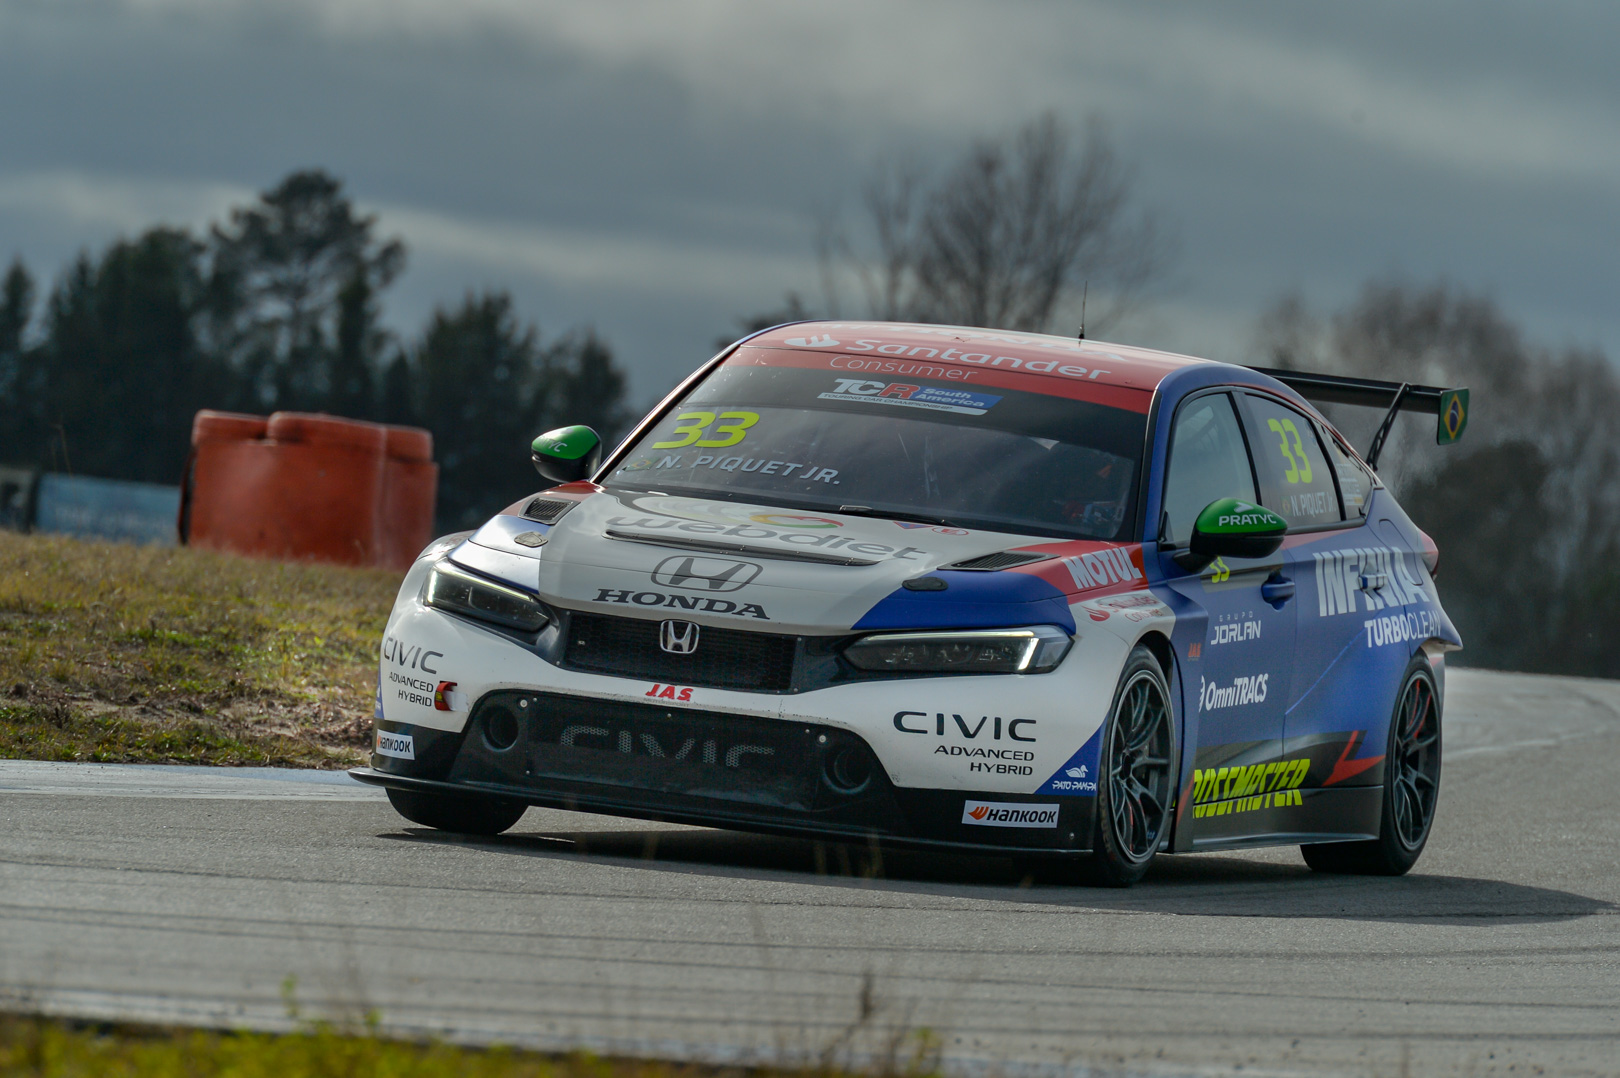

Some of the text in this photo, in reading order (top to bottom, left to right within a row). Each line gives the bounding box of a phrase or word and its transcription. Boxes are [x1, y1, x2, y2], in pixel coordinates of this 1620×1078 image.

[830, 356, 978, 380] Consumer
[846, 339, 1111, 379] Santander
[823, 393, 862, 401] TOURING
[833, 378, 920, 399] TCR
[915, 393, 985, 407] America
[923, 388, 972, 399] South
[651, 411, 760, 449] 33
[1267, 418, 1312, 484] 33
[655, 455, 841, 485] N. PIQUET JR.
[1300, 492, 1326, 518] PIQUET
[1218, 514, 1277, 527] PRATYC
[605, 516, 927, 561] webdiet
[1061, 547, 1143, 589] MOTUL
[592, 588, 770, 620] HONDA
[1219, 611, 1253, 622] GRUPO
[1211, 620, 1261, 645] JORLAN
[1364, 611, 1441, 648] TURBOCLEAN
[384, 637, 443, 674] CIVIC
[389, 671, 433, 692] ADVANCED
[1205, 673, 1268, 711] OmniTRACS
[398, 689, 432, 707] HYBRID
[893, 711, 1037, 742] CIVIC
[934, 745, 1034, 761] ADVANCED
[970, 762, 1033, 776] HYBRID
[1052, 780, 1071, 790] PATO
